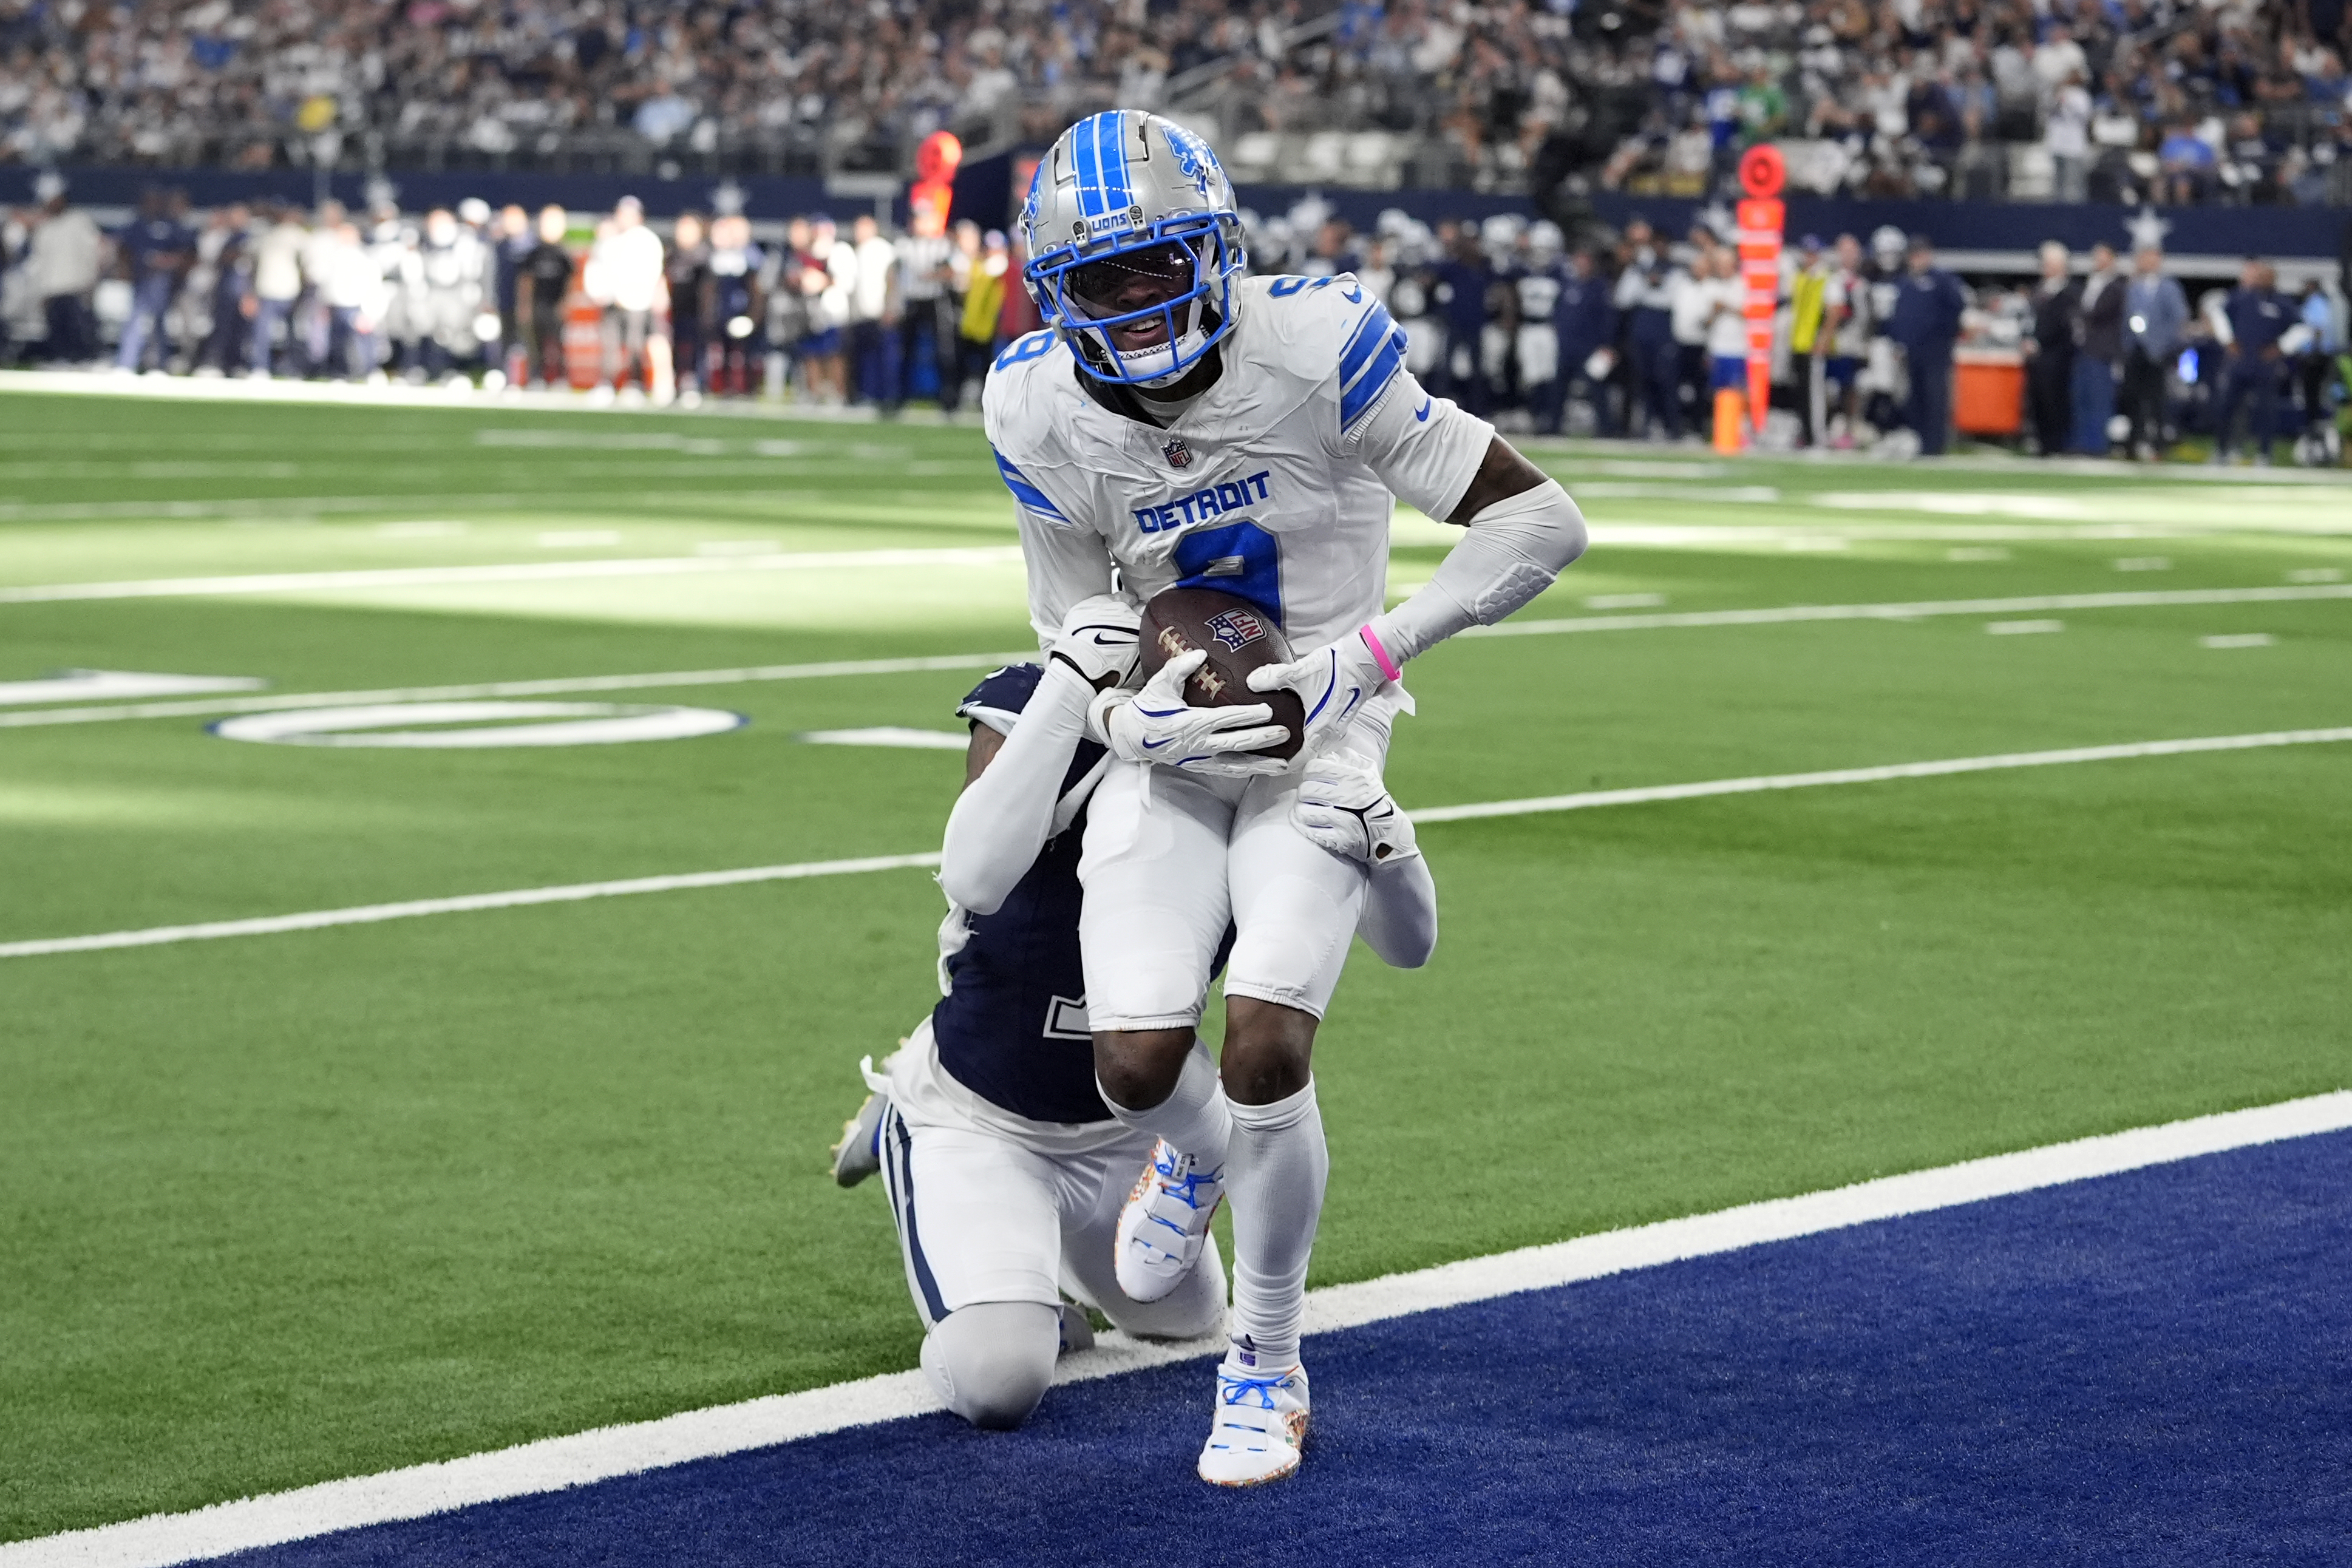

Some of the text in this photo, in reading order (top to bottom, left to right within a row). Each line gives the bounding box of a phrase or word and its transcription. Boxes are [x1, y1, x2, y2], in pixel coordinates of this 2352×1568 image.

[1092, 213, 1127, 232] LIONS
[994, 331, 1056, 374] 9
[1170, 451, 1189, 466] NFL
[1131, 470, 1270, 534] DETROIT
[1229, 611, 1262, 639] NFL
